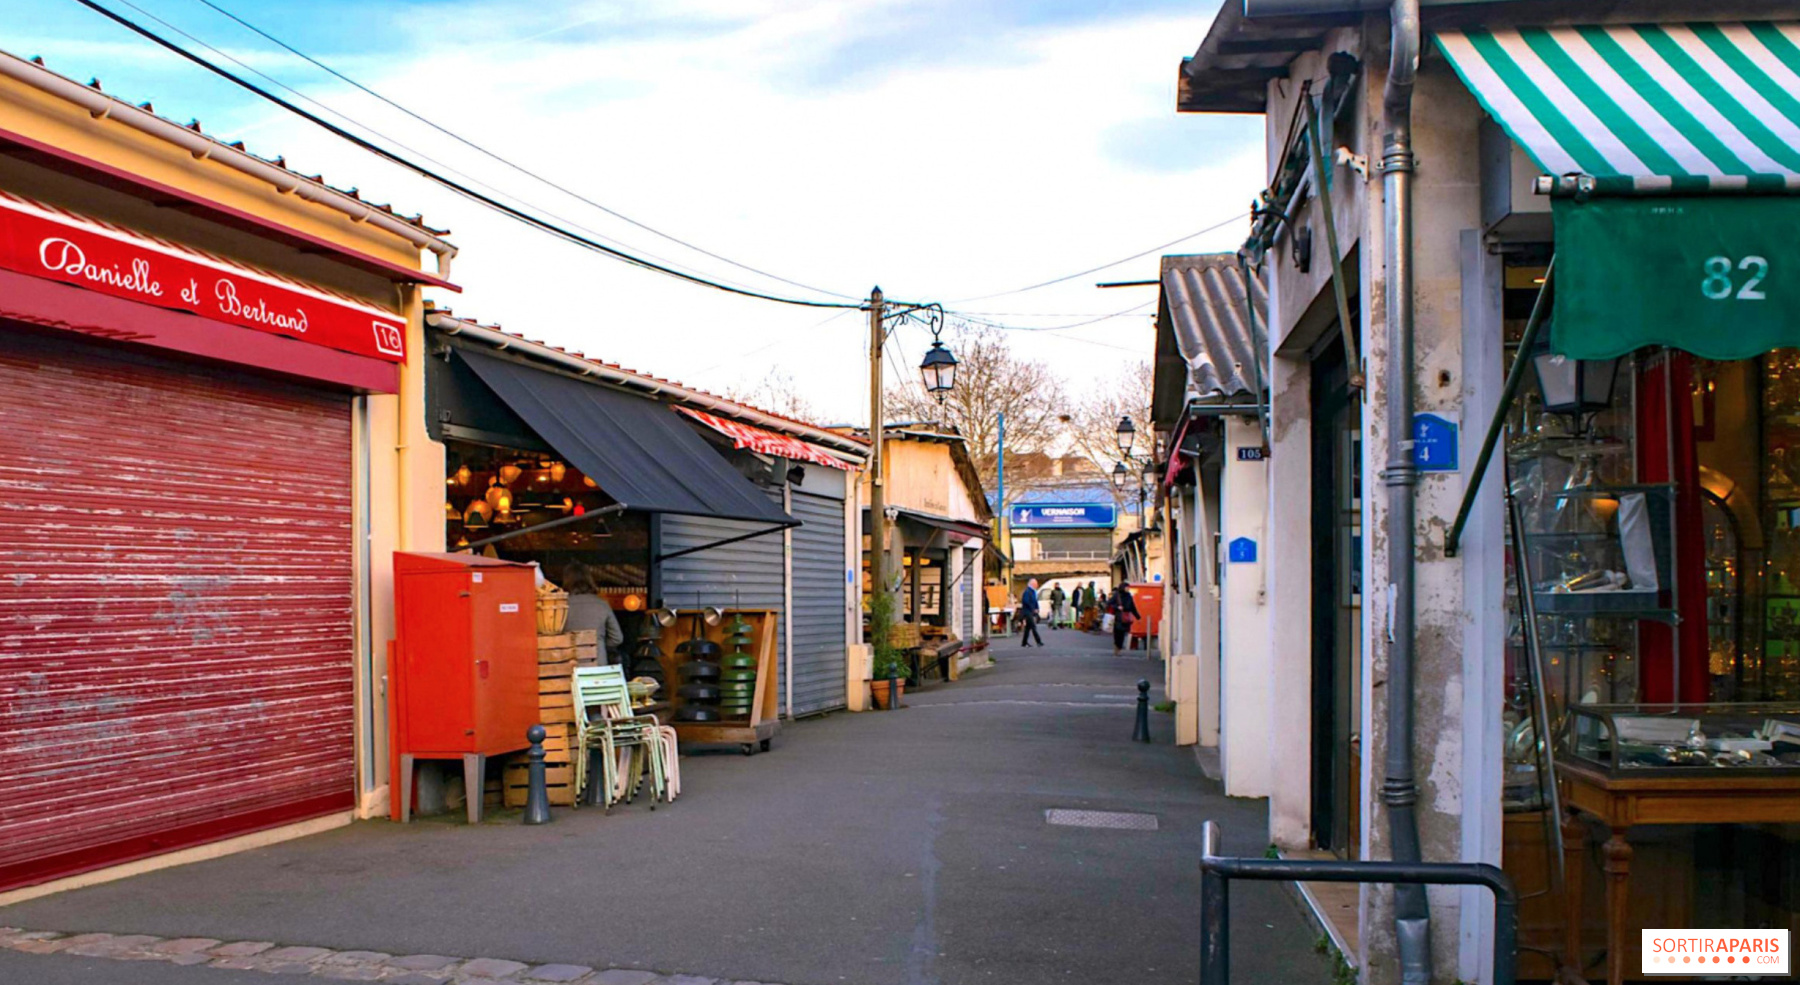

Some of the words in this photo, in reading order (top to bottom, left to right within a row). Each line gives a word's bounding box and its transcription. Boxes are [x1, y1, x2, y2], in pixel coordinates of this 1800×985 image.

[39, 237, 164, 297] Danielle
[180, 279, 200, 305] et
[214, 278, 309, 333] Bertrand
[1701, 255, 1769, 301] 82
[380, 328, 401, 349] 16
[1242, 449, 1262, 459] 105
[1419, 446, 1430, 462] 4
[1041, 507, 1085, 516] VERNAISON
